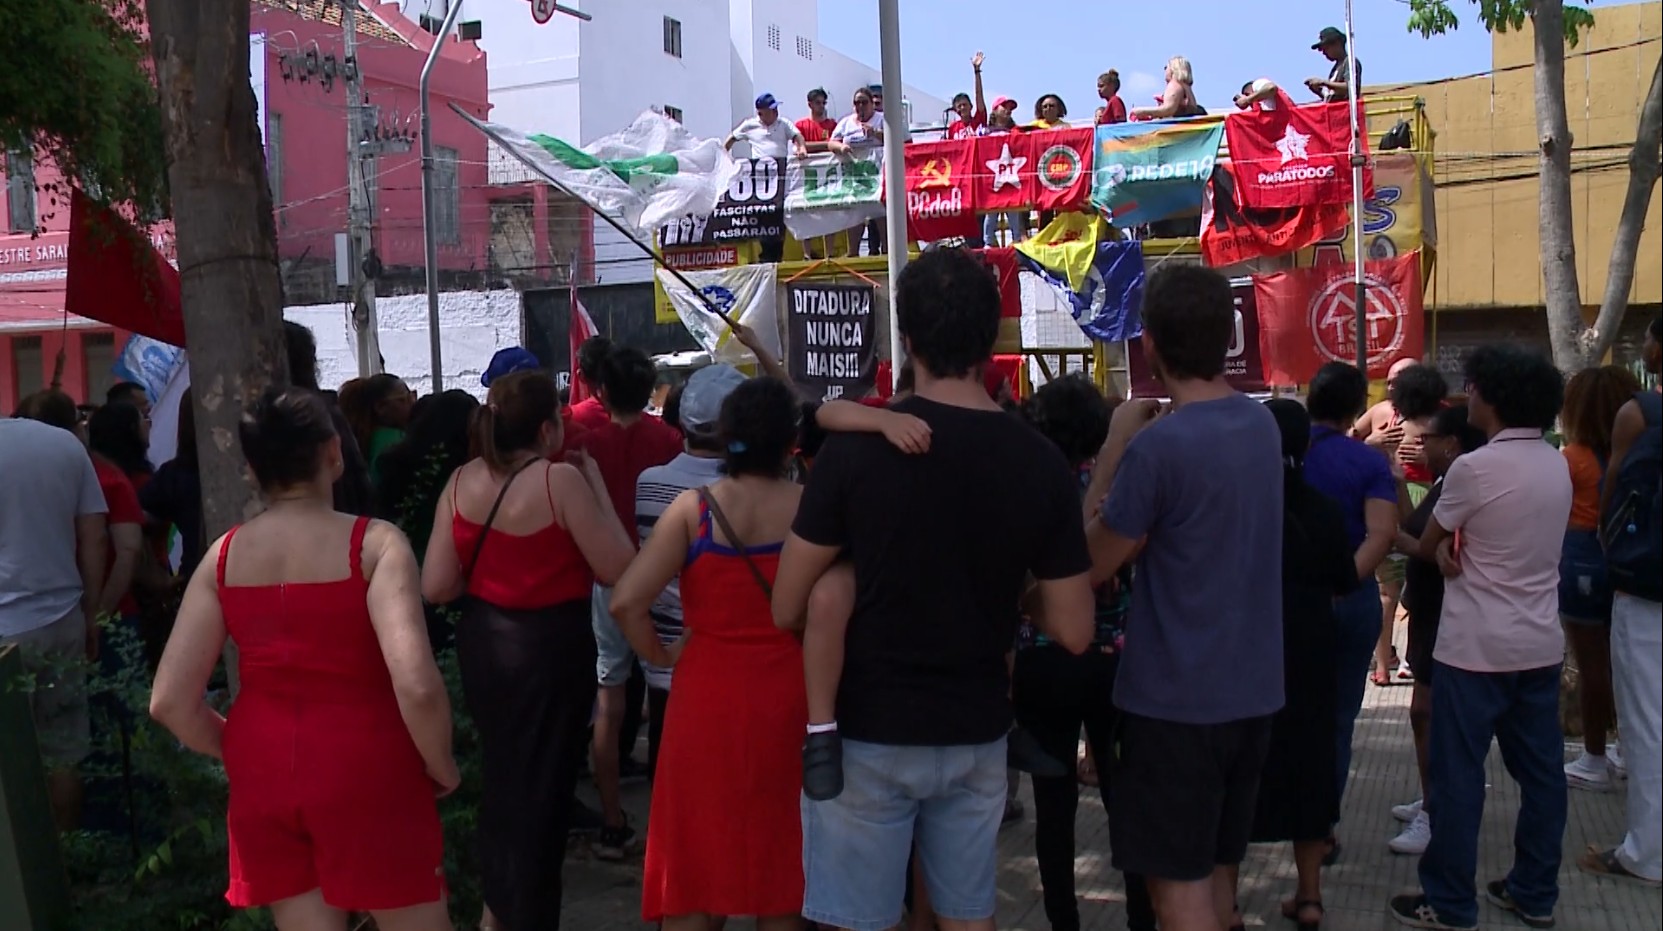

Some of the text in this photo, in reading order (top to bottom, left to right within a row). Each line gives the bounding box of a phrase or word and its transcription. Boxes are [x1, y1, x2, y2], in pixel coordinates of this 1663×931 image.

[998, 163, 1015, 175] PT
[1257, 164, 1335, 184] PARATODOS
[713, 204, 776, 217] FASCISTAS
[907, 187, 962, 220] PCdoB
[665, 249, 735, 267] PUBLICIDADE
[794, 288, 870, 315] DITADURA
[806, 321, 862, 346] NUNCA
[806, 351, 859, 378] MAIS!!!
